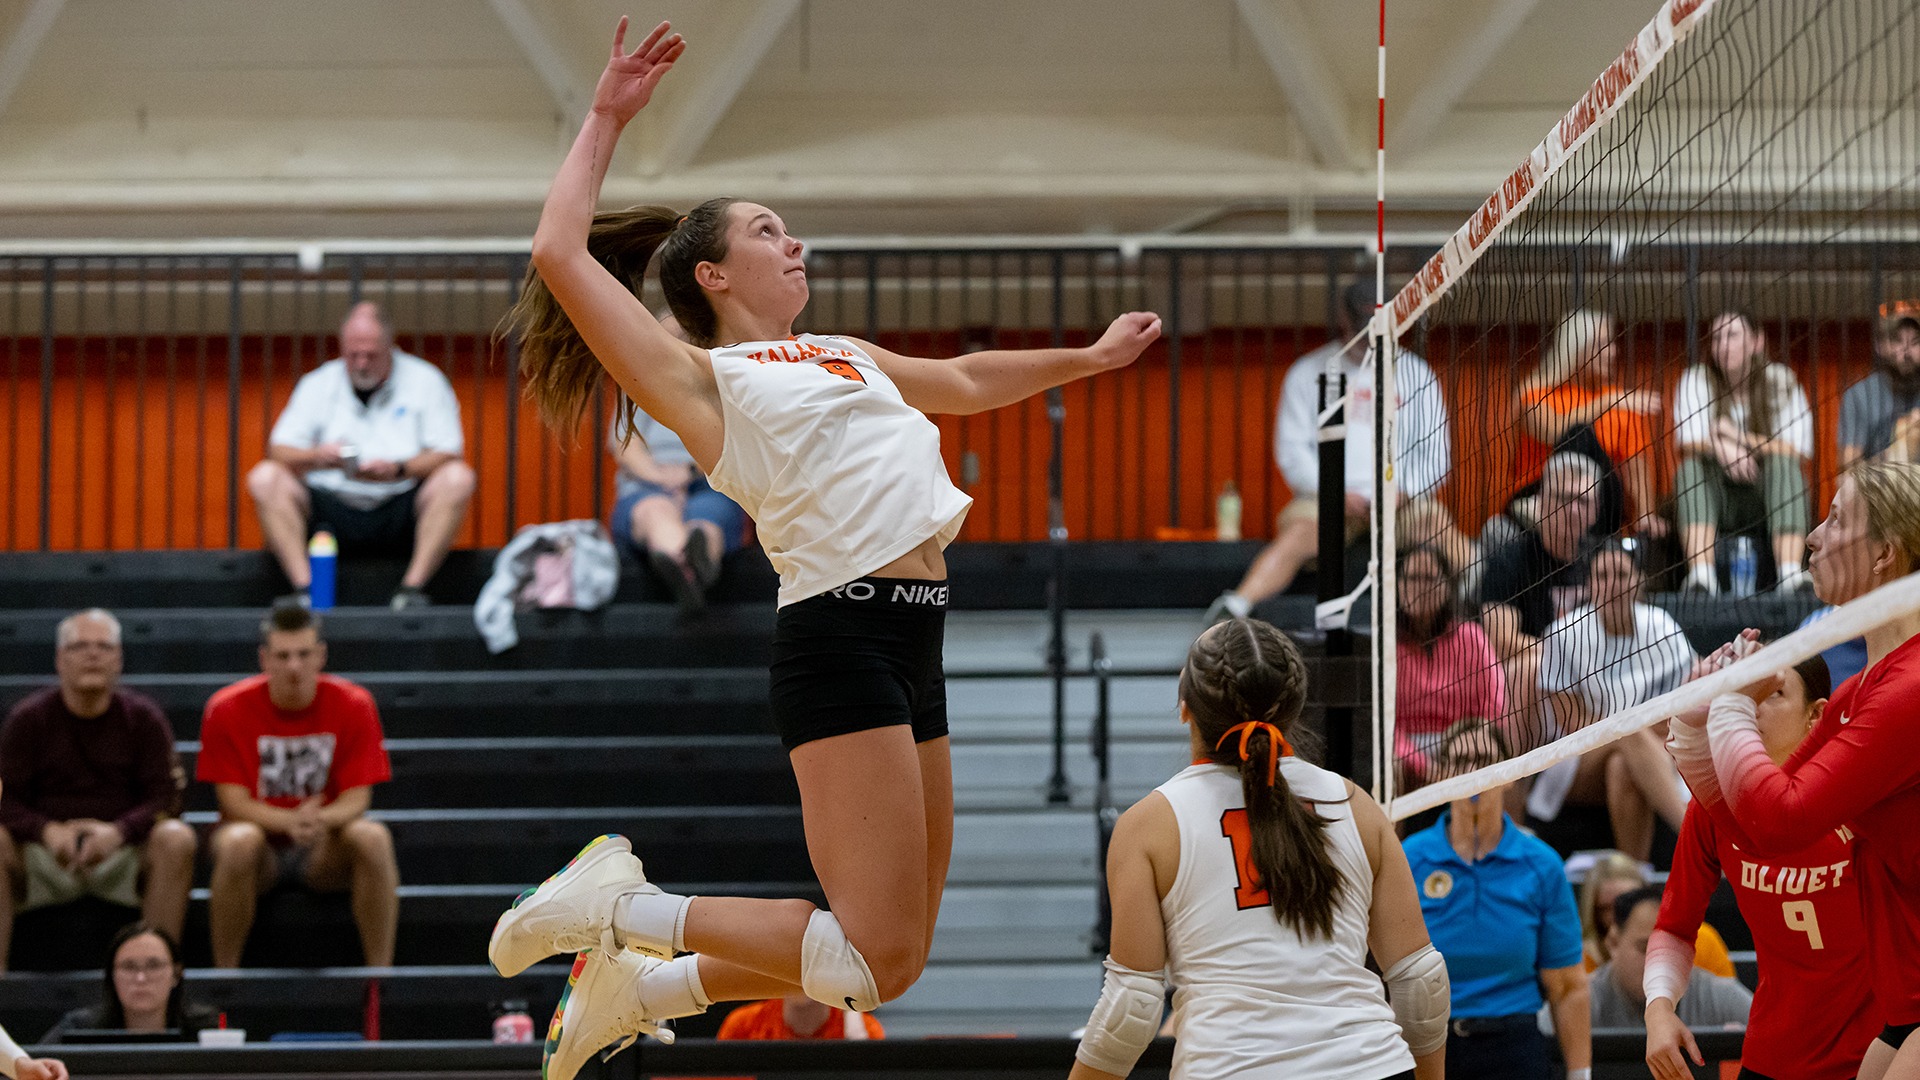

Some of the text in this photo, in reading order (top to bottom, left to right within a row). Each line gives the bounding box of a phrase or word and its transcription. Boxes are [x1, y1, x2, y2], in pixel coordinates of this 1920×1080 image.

[820, 582, 947, 606] RO NIKE
[1741, 860, 1850, 895] OLIVET
[1782, 900, 1825, 950] 9
